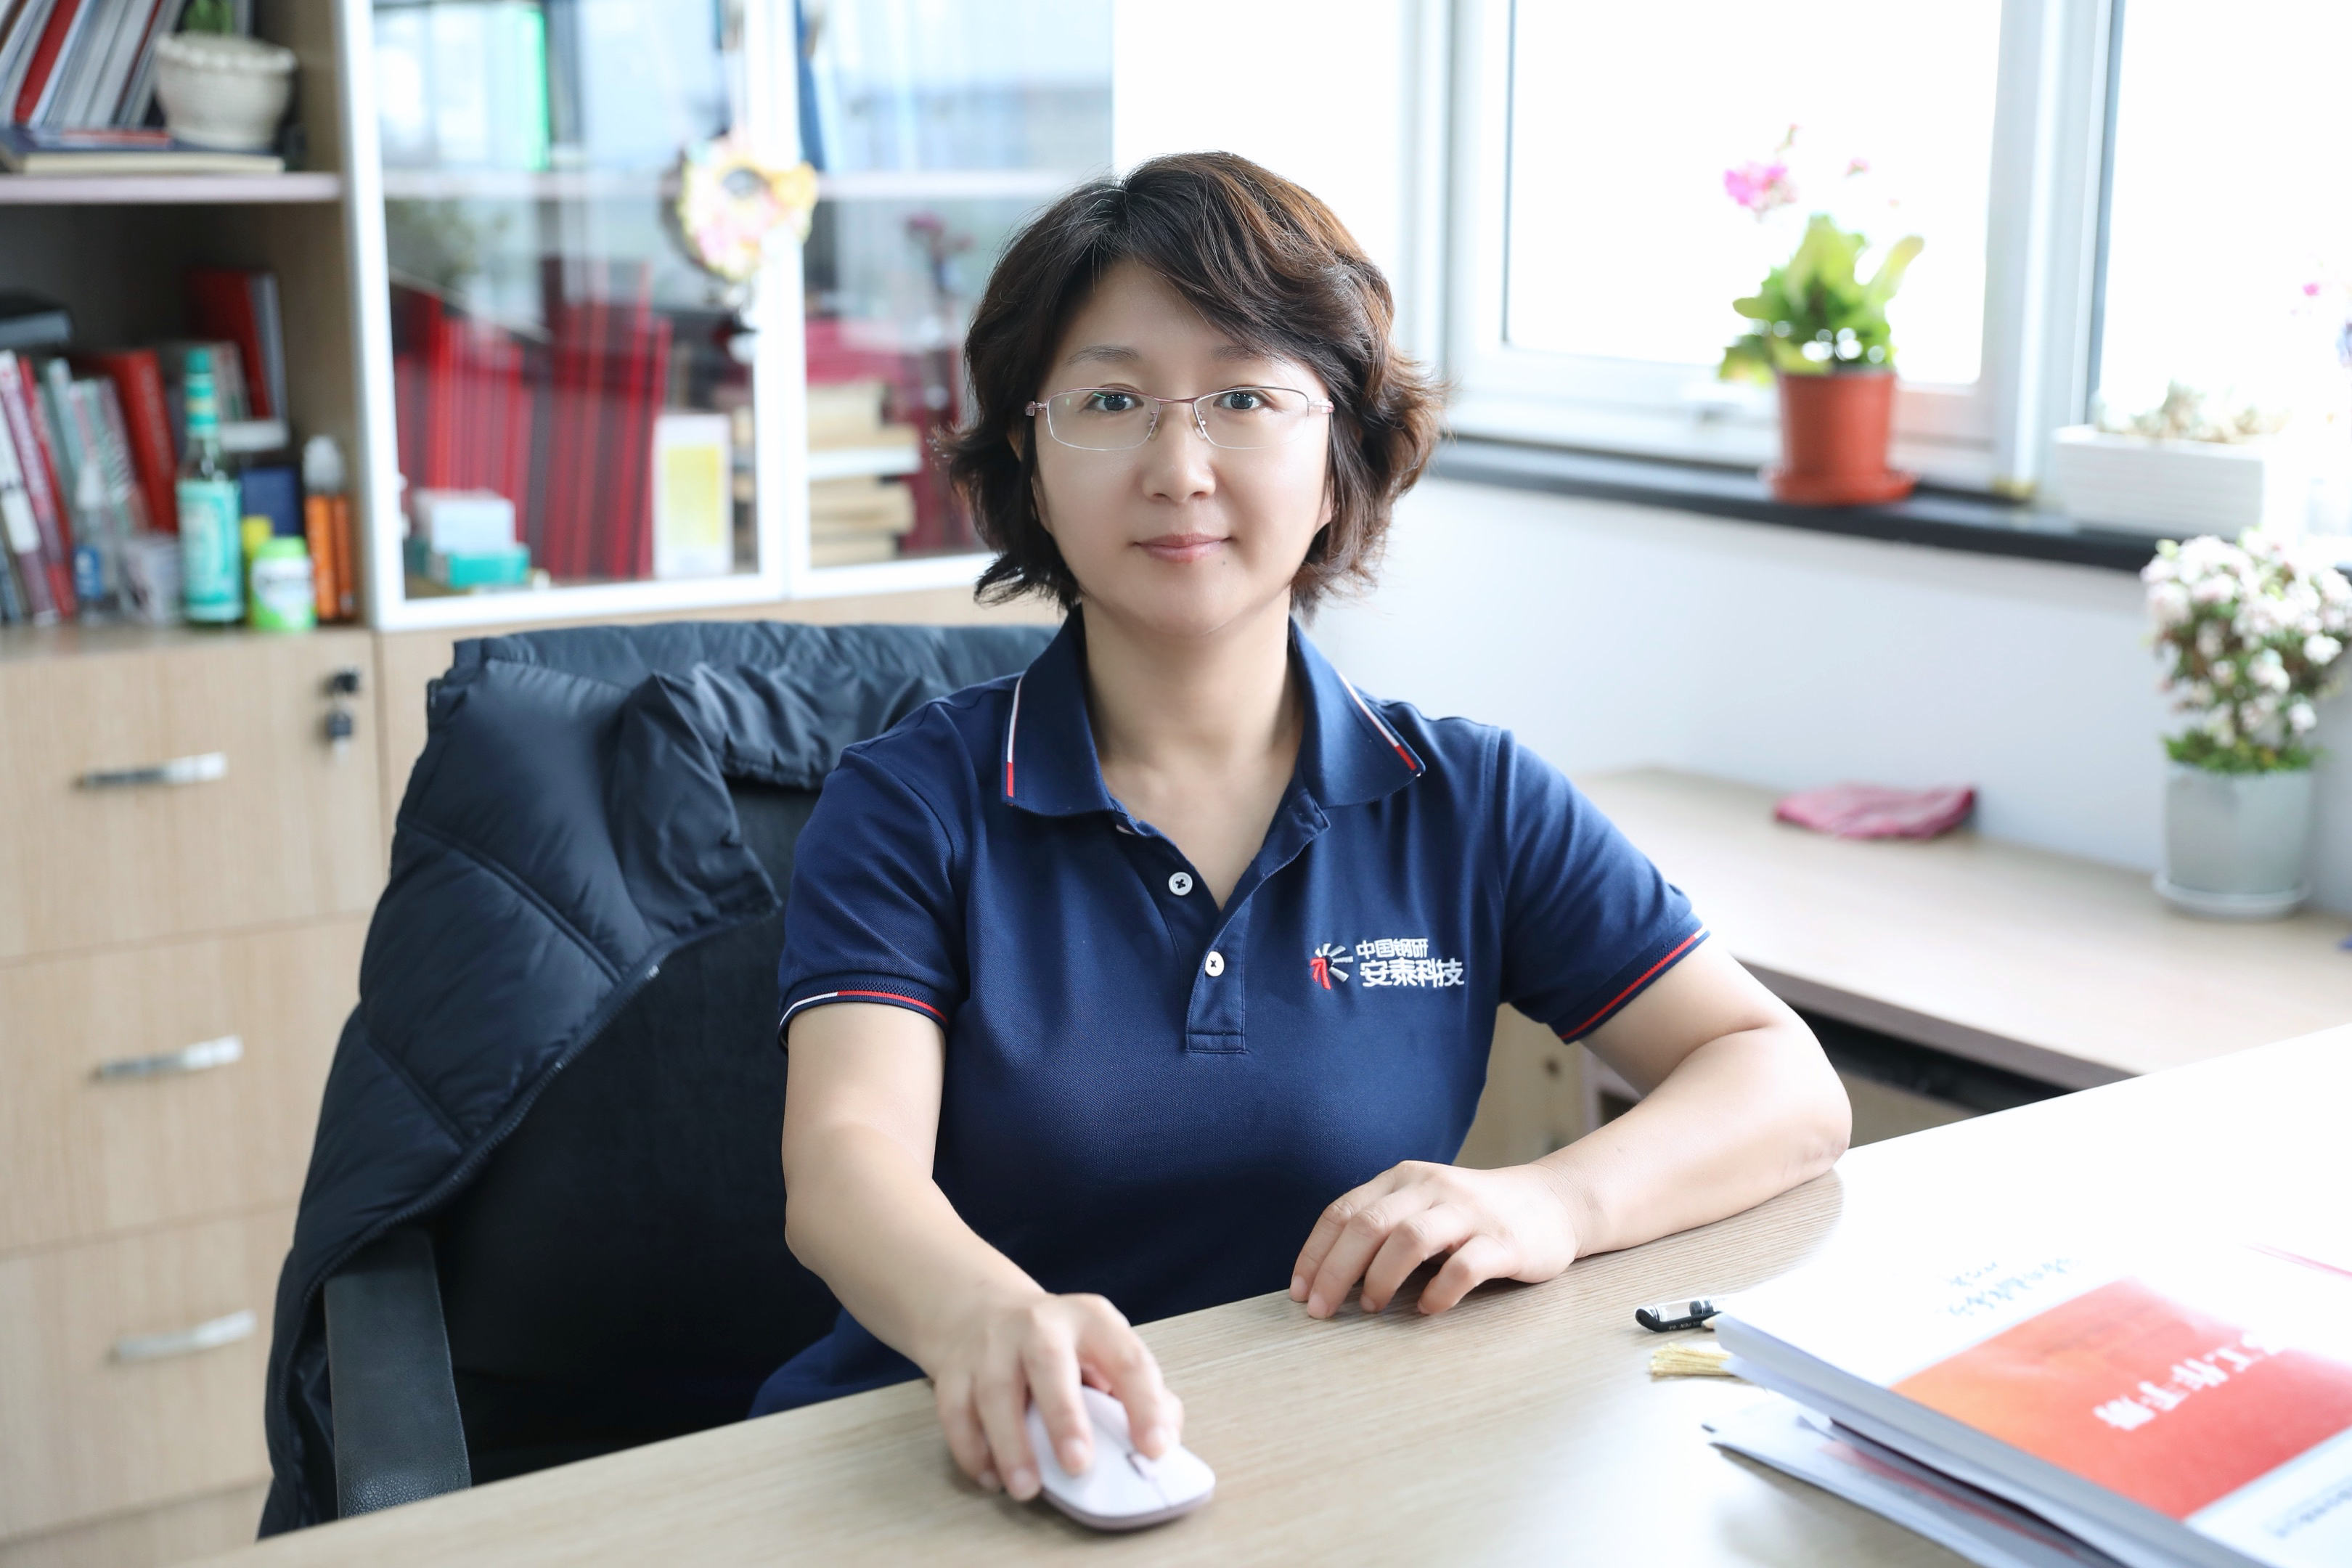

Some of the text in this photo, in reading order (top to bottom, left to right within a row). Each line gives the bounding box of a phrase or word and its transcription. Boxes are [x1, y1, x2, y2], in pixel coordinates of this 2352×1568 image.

[1355, 938, 1429, 960] 中国钢研
[1360, 957, 1465, 988] 安泰科技
